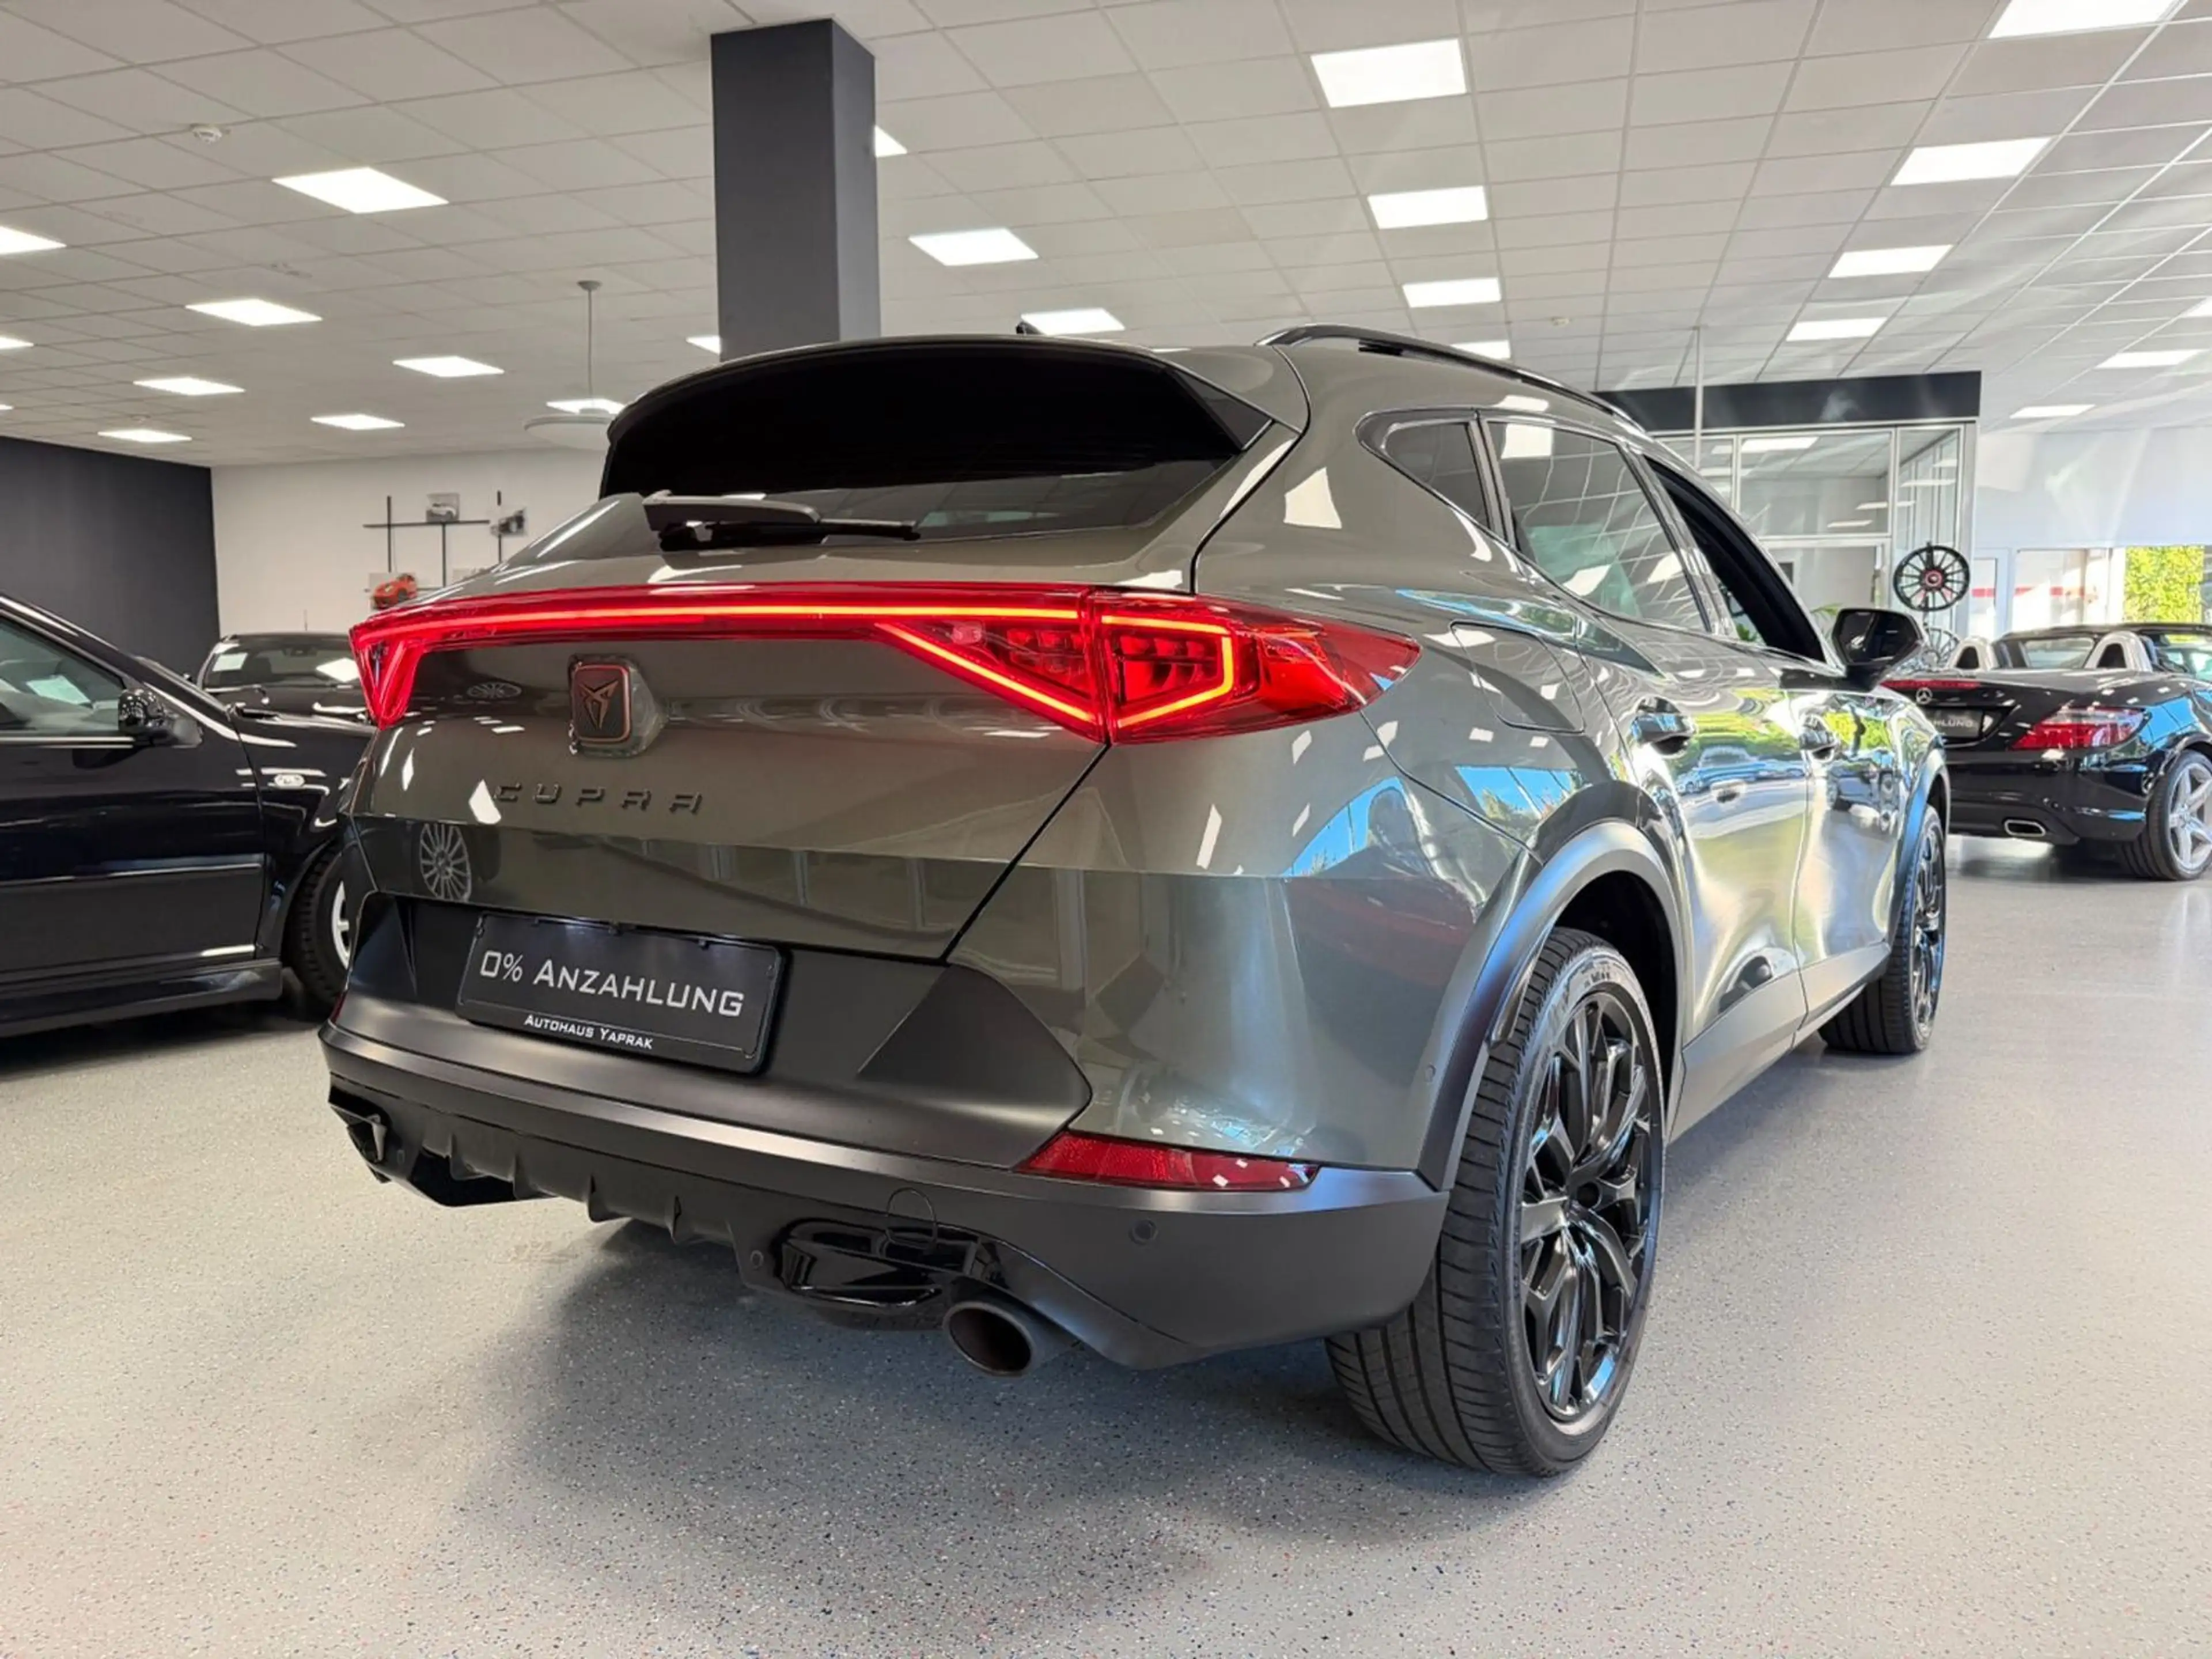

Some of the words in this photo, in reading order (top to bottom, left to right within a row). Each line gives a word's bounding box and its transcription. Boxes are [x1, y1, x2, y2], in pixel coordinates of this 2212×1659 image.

[493, 782, 704, 815] CUPRA
[480, 950, 523, 982] 0%
[533, 959, 744, 1017] ANZAHLUNG
[524, 1014, 594, 1038] AUTOHAUS
[599, 1028, 653, 1050] YAPRAK
